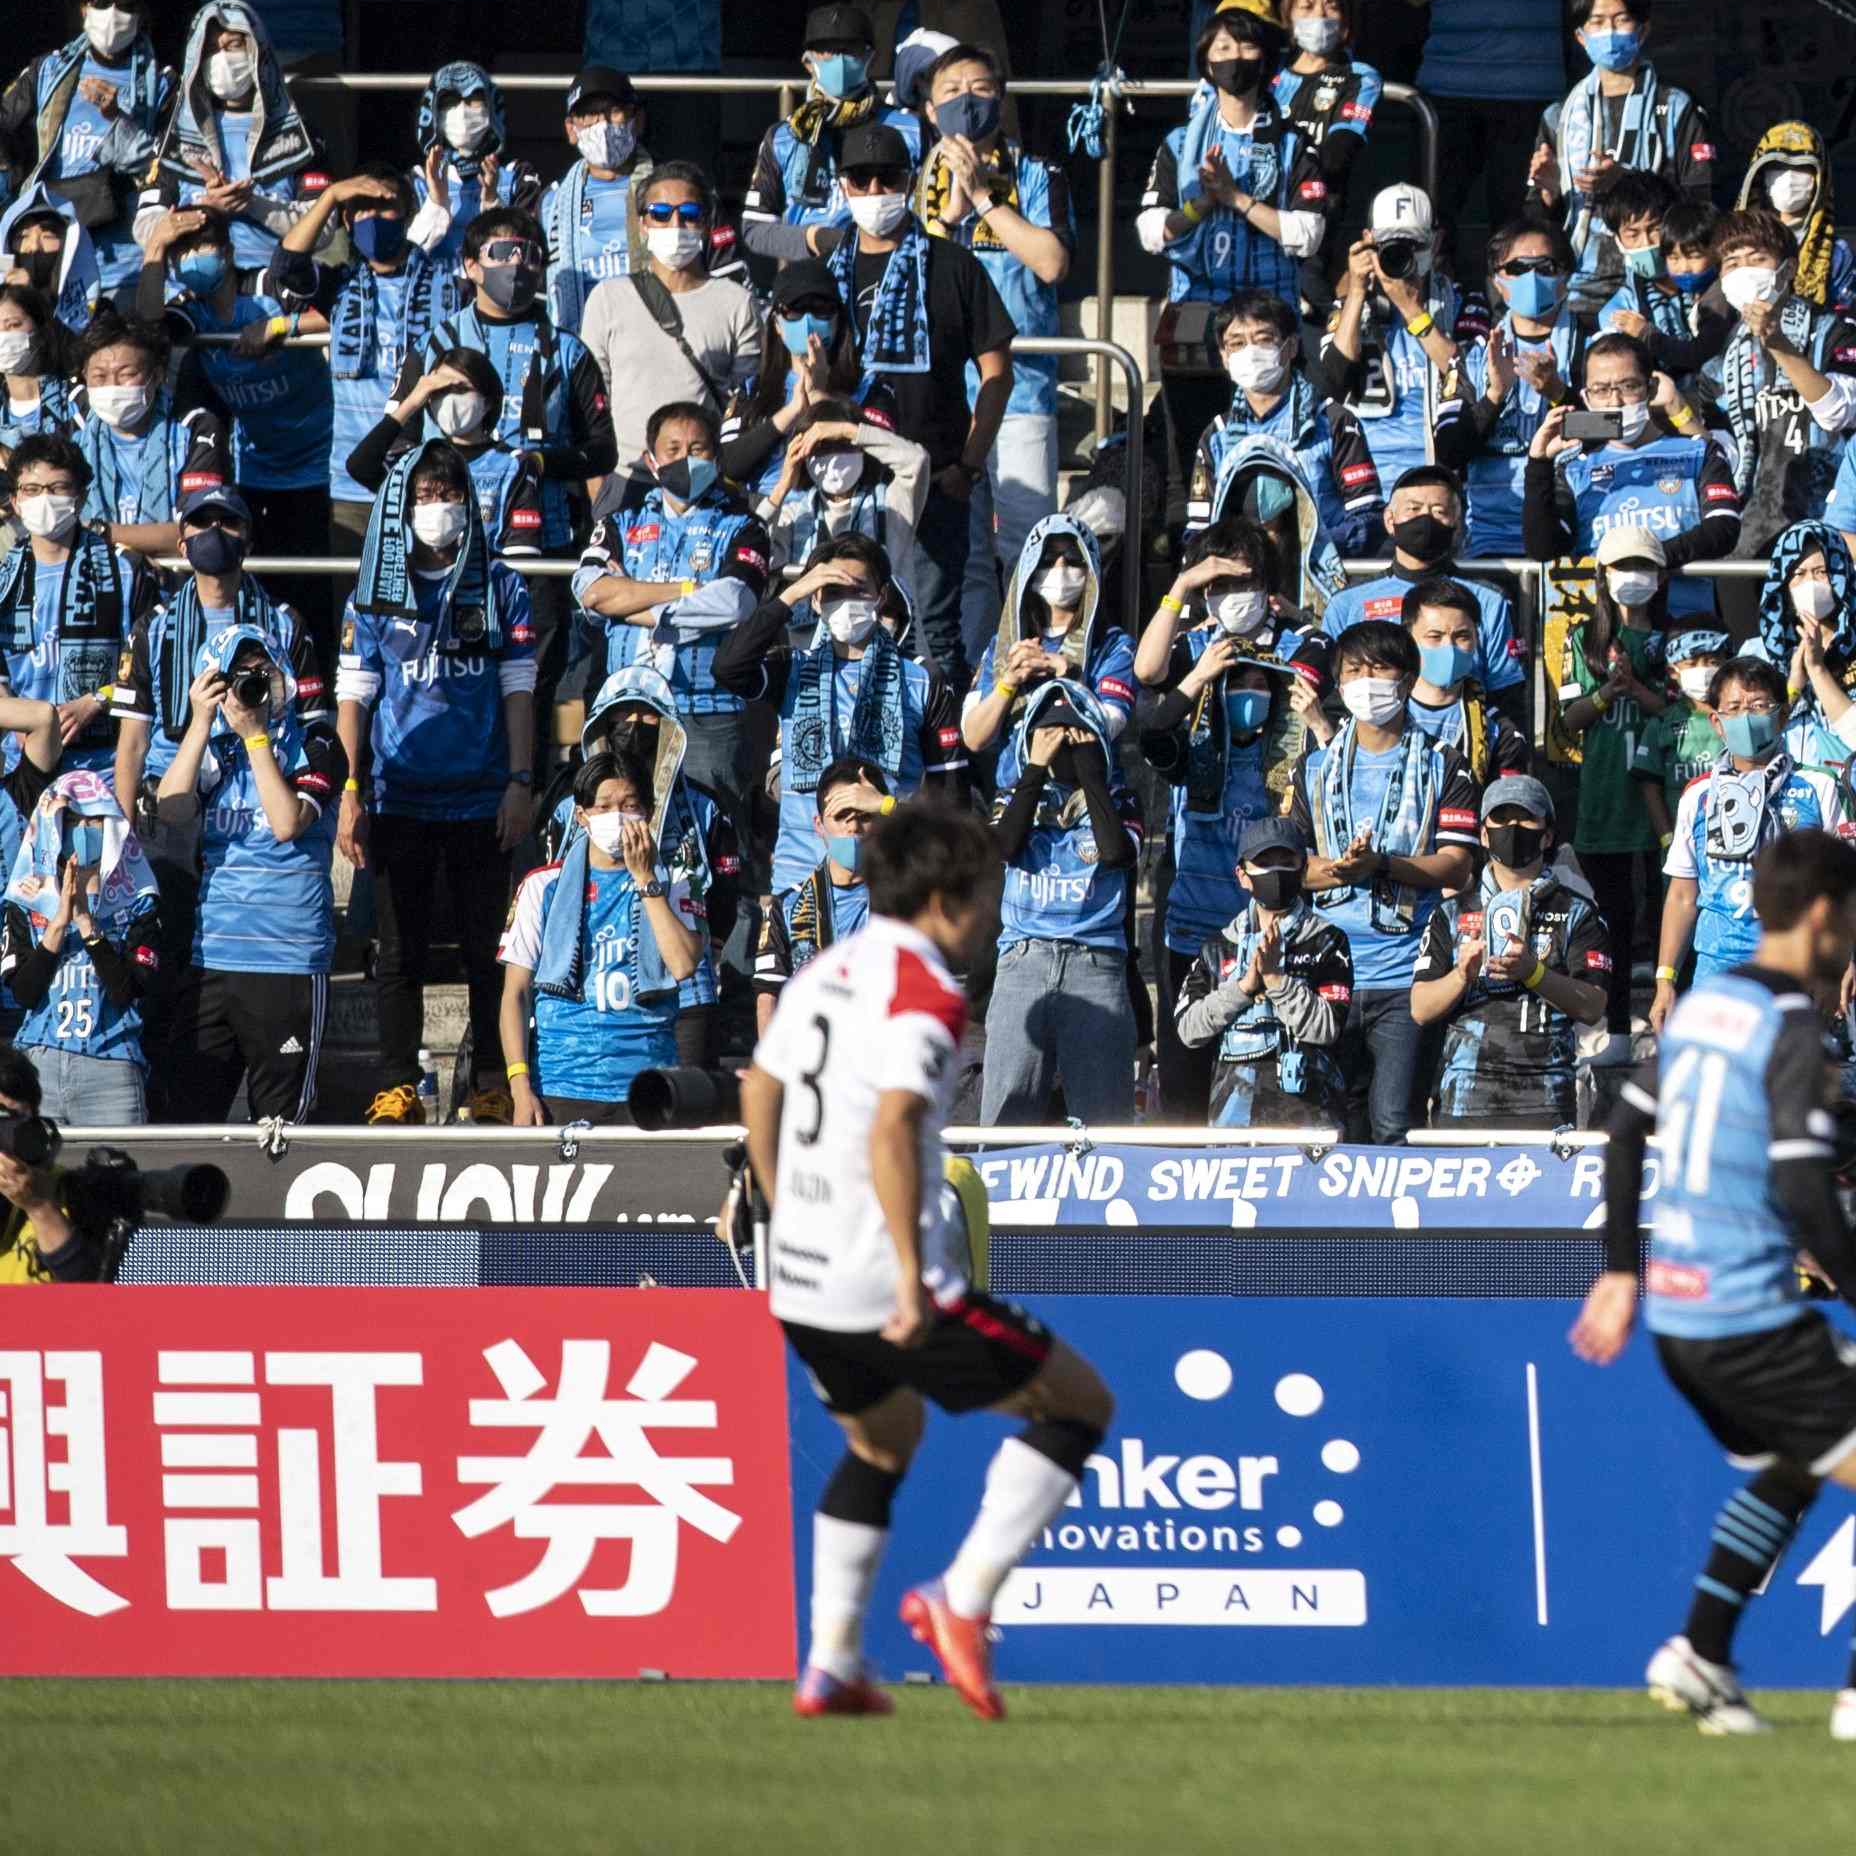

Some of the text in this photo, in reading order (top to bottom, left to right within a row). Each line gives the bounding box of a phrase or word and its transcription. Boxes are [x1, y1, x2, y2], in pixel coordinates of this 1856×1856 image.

[1395, 197, 1412, 221] F
[1214, 230, 1231, 270] 9
[1784, 418, 1804, 456] 4
[1533, 910, 1569, 924] NOSY
[594, 971, 630, 1013] 10
[1518, 992, 1547, 1034] 11
[56, 998, 93, 1040] 25
[796, 1013, 831, 1147] 3
[1147, 1156, 1304, 1200] SWEET
[1318, 1157, 1492, 1200] SNIPER
[1080, 1437, 1280, 1512] nker
[1022, 1583, 1322, 1612] JAPAN
